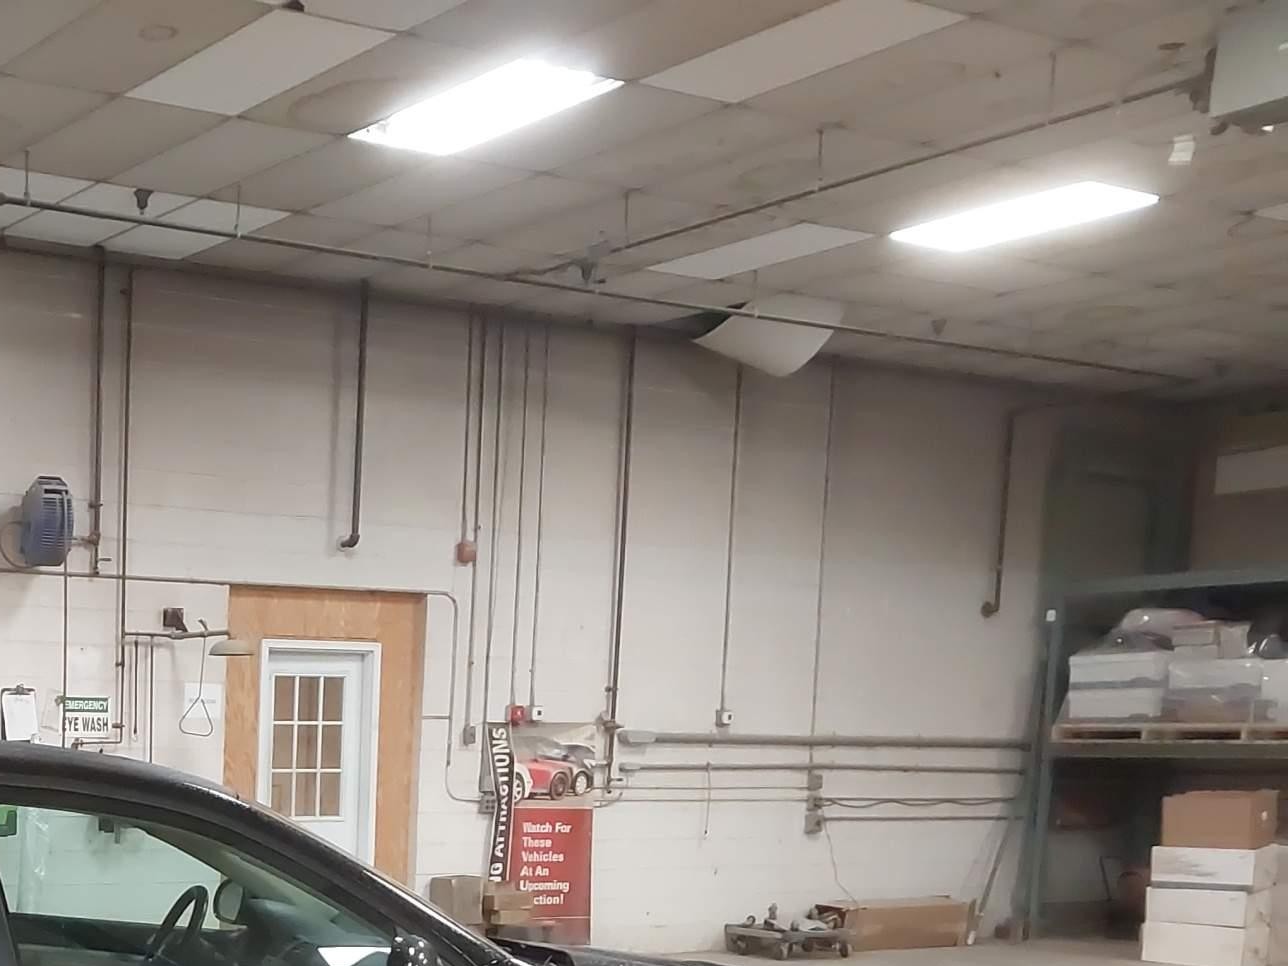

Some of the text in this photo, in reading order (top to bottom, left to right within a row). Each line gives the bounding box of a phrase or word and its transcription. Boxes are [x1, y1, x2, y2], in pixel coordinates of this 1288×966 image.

[82, 716, 109, 732] WASH
[522, 822, 572, 833] Watch For
[522, 836, 553, 848] These
[521, 851, 565, 862] Vehicles
[520, 865, 550, 877] At An
[519, 880, 570, 893] Upcoming
[533, 893, 565, 905] ction!
